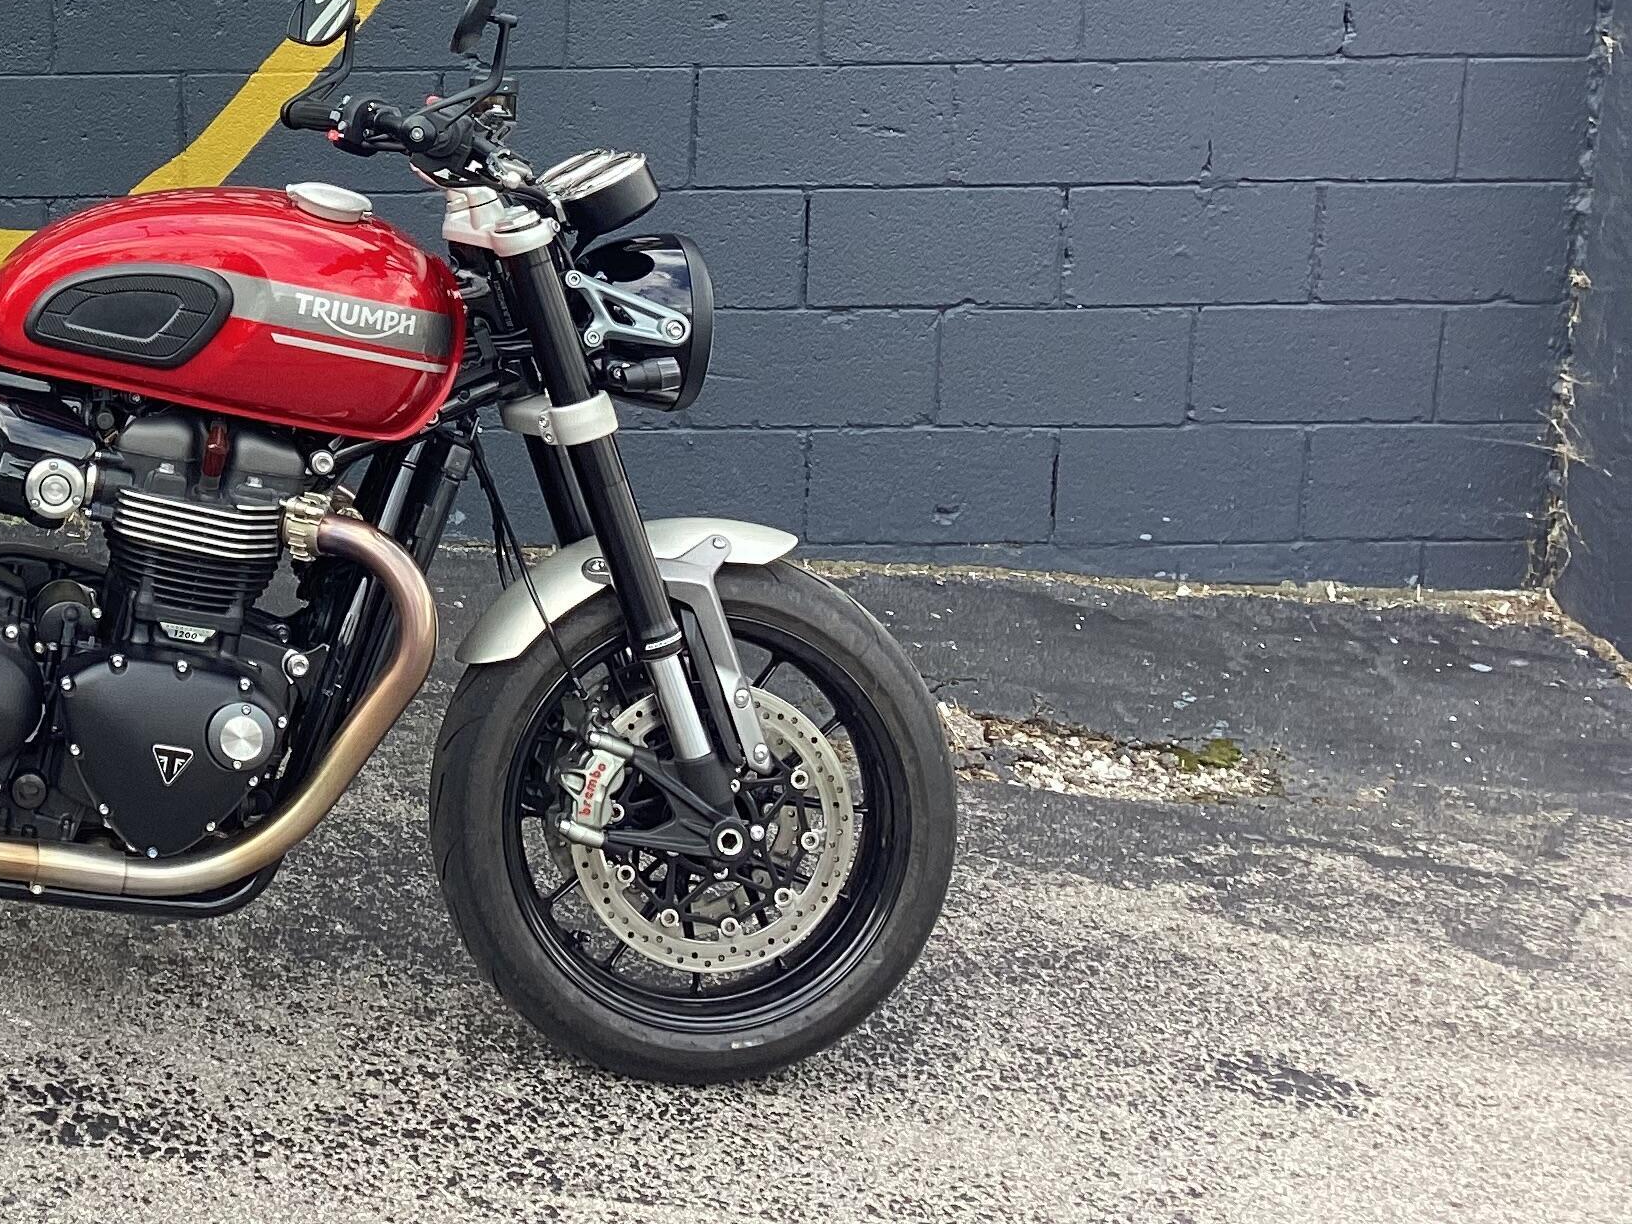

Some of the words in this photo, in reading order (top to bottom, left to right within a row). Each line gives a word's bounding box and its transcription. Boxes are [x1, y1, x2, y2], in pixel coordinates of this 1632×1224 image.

[295, 291, 416, 339] TRIUMPH
[174, 629, 198, 640] 1200
[578, 763, 607, 816] brembo
